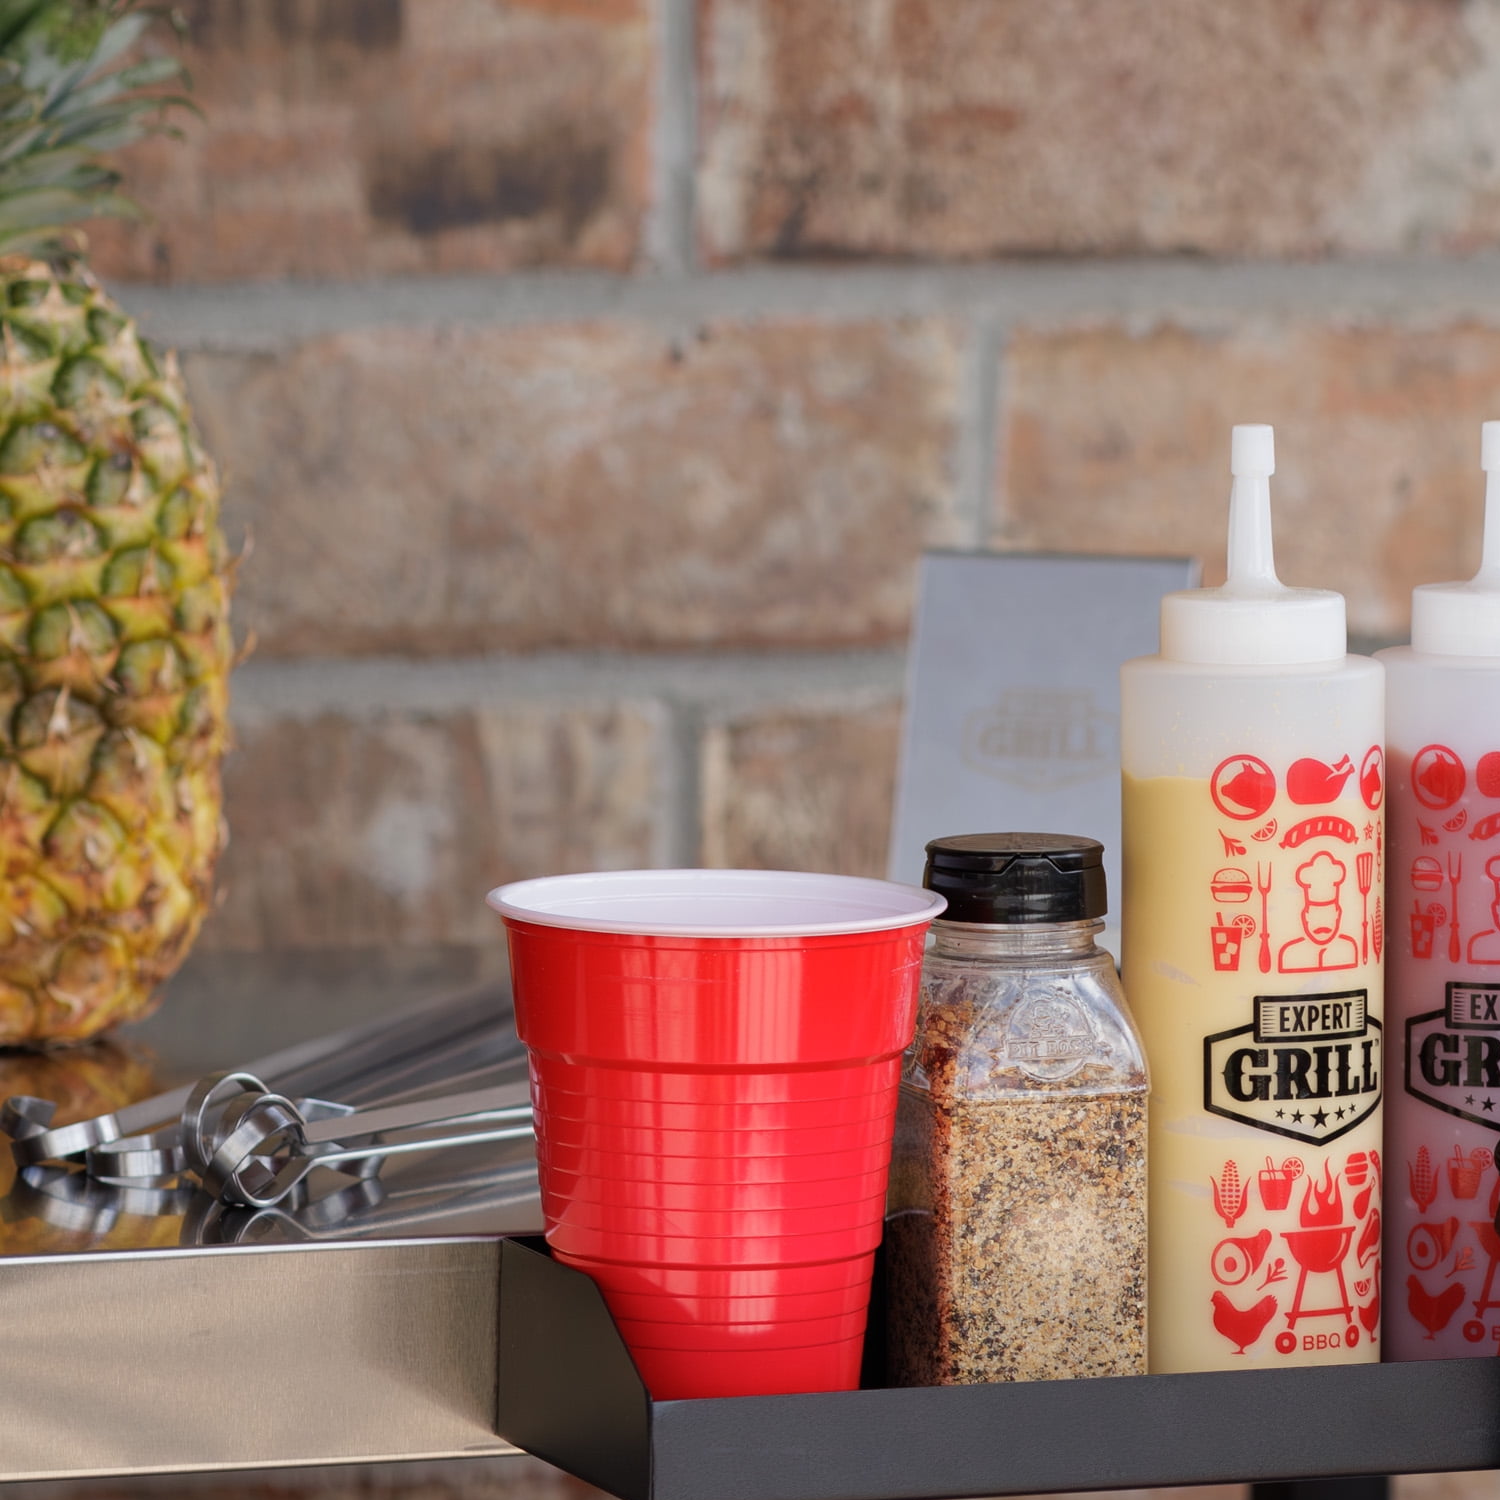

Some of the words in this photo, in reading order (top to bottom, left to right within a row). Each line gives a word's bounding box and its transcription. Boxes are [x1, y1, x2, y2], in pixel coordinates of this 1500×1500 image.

[1279, 1002, 1352, 1032] EXPERT
[1221, 1040, 1377, 1102] GRILL
[1303, 1333, 1341, 1350] BBQ
